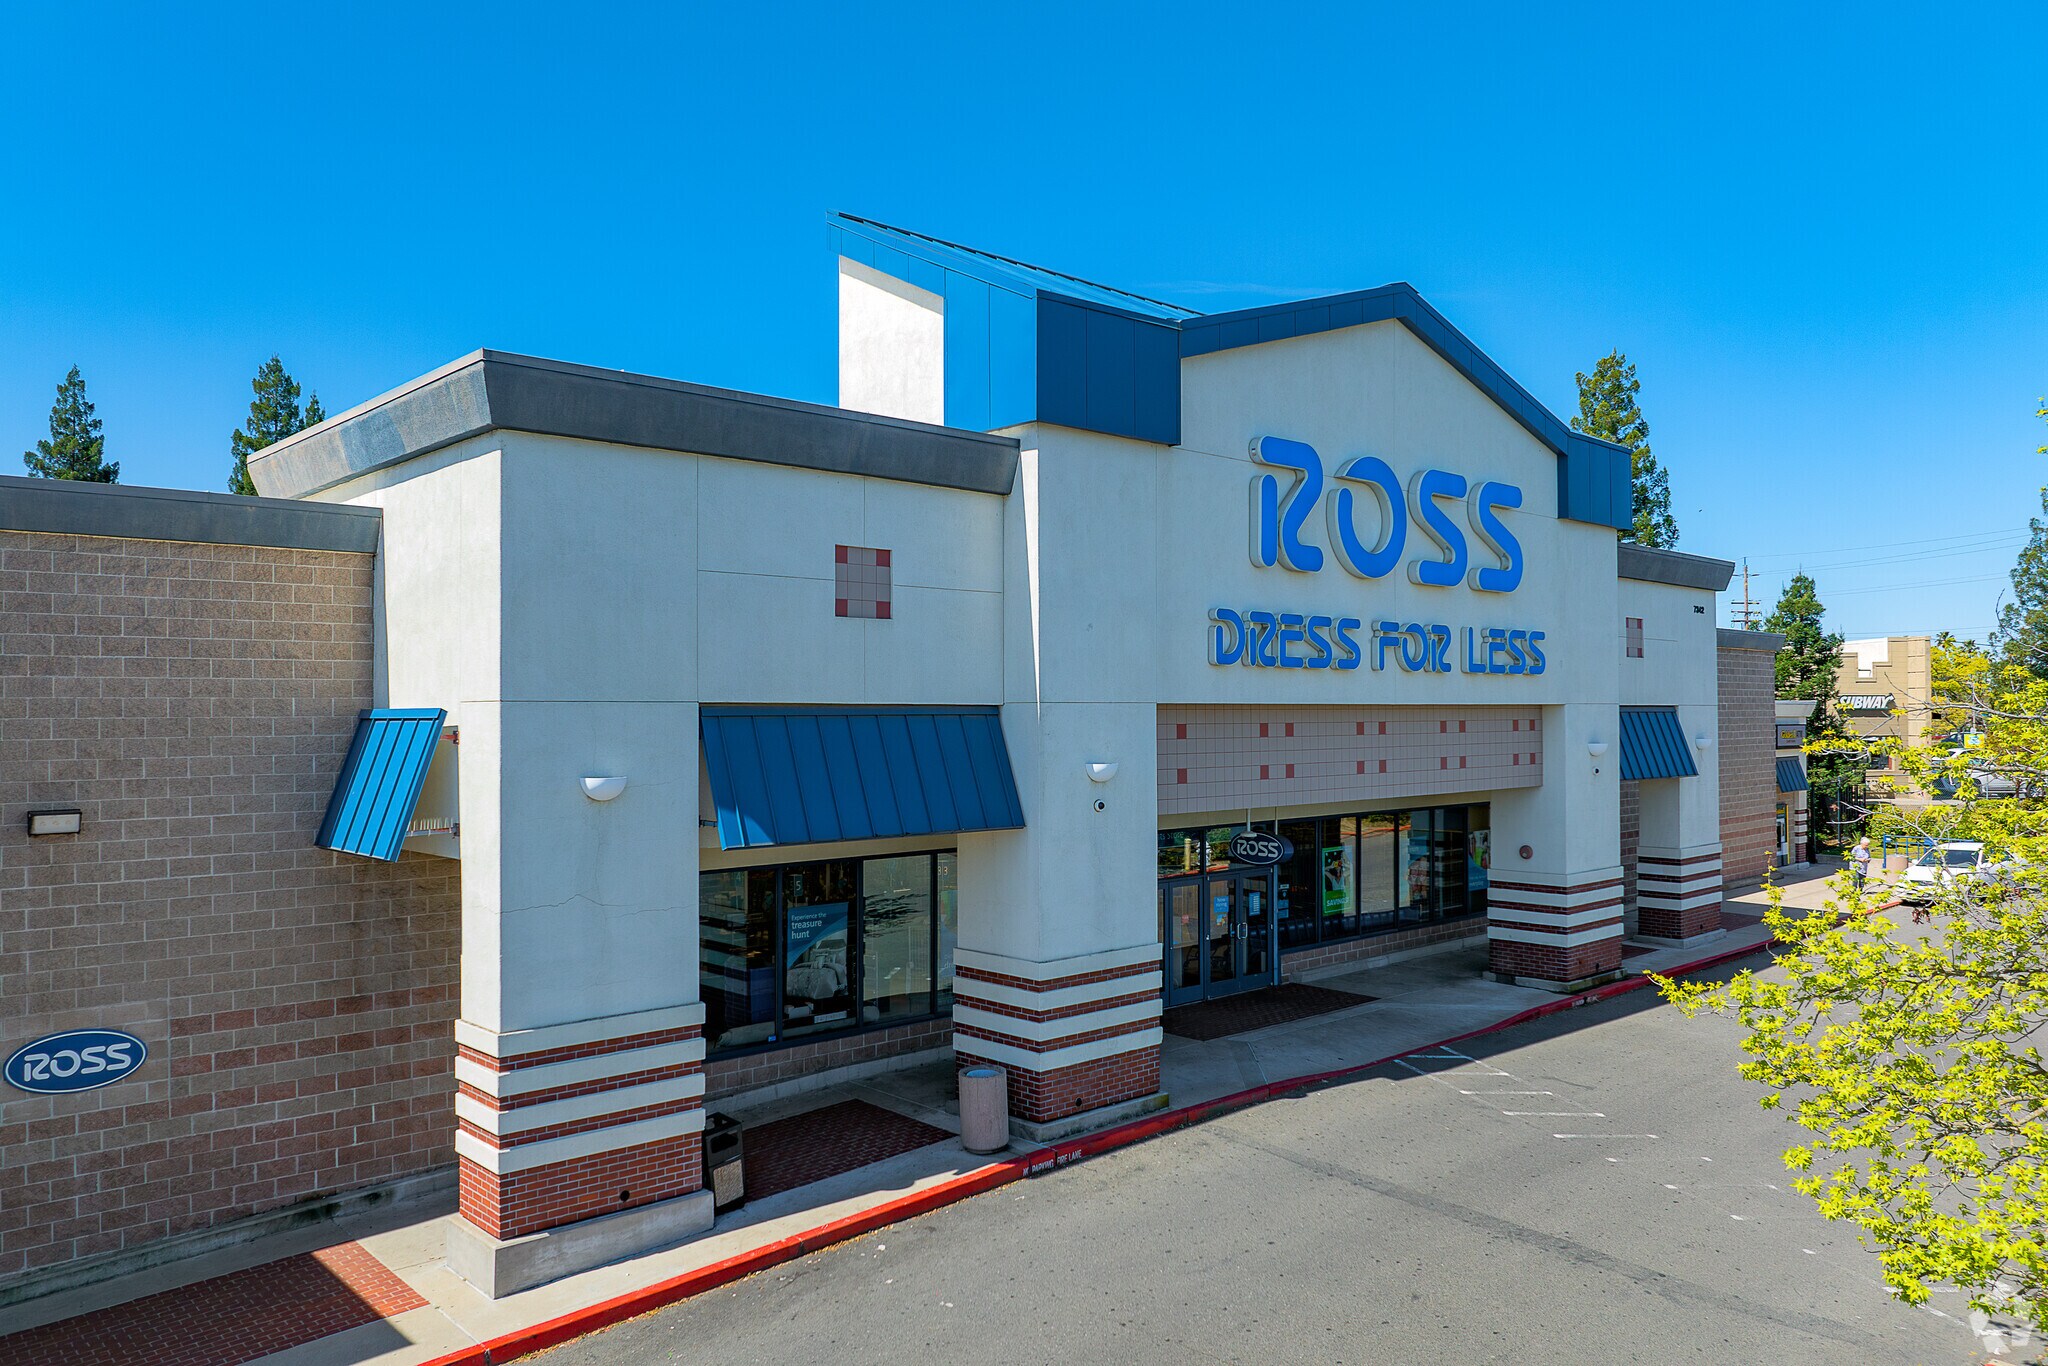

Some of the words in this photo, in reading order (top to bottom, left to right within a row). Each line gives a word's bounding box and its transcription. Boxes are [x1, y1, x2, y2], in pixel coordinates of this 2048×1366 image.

[1248, 435, 1523, 592] ROSS
[1208, 607, 1361, 670] DRESS
[1371, 620, 1452, 672] FOR
[1461, 626, 1546, 675] LESS
[1839, 695, 1894, 709] SUBWAY
[1237, 839, 1279, 858] ROSS
[791, 913, 818, 922] Experience
[791, 919, 823, 930] treasure
[791, 930, 810, 939] hunt
[23, 1042, 132, 1082] ROSS
[1057, 1154, 1067, 1165] FIRE
[1068, 1149, 1082, 1160] LANE
